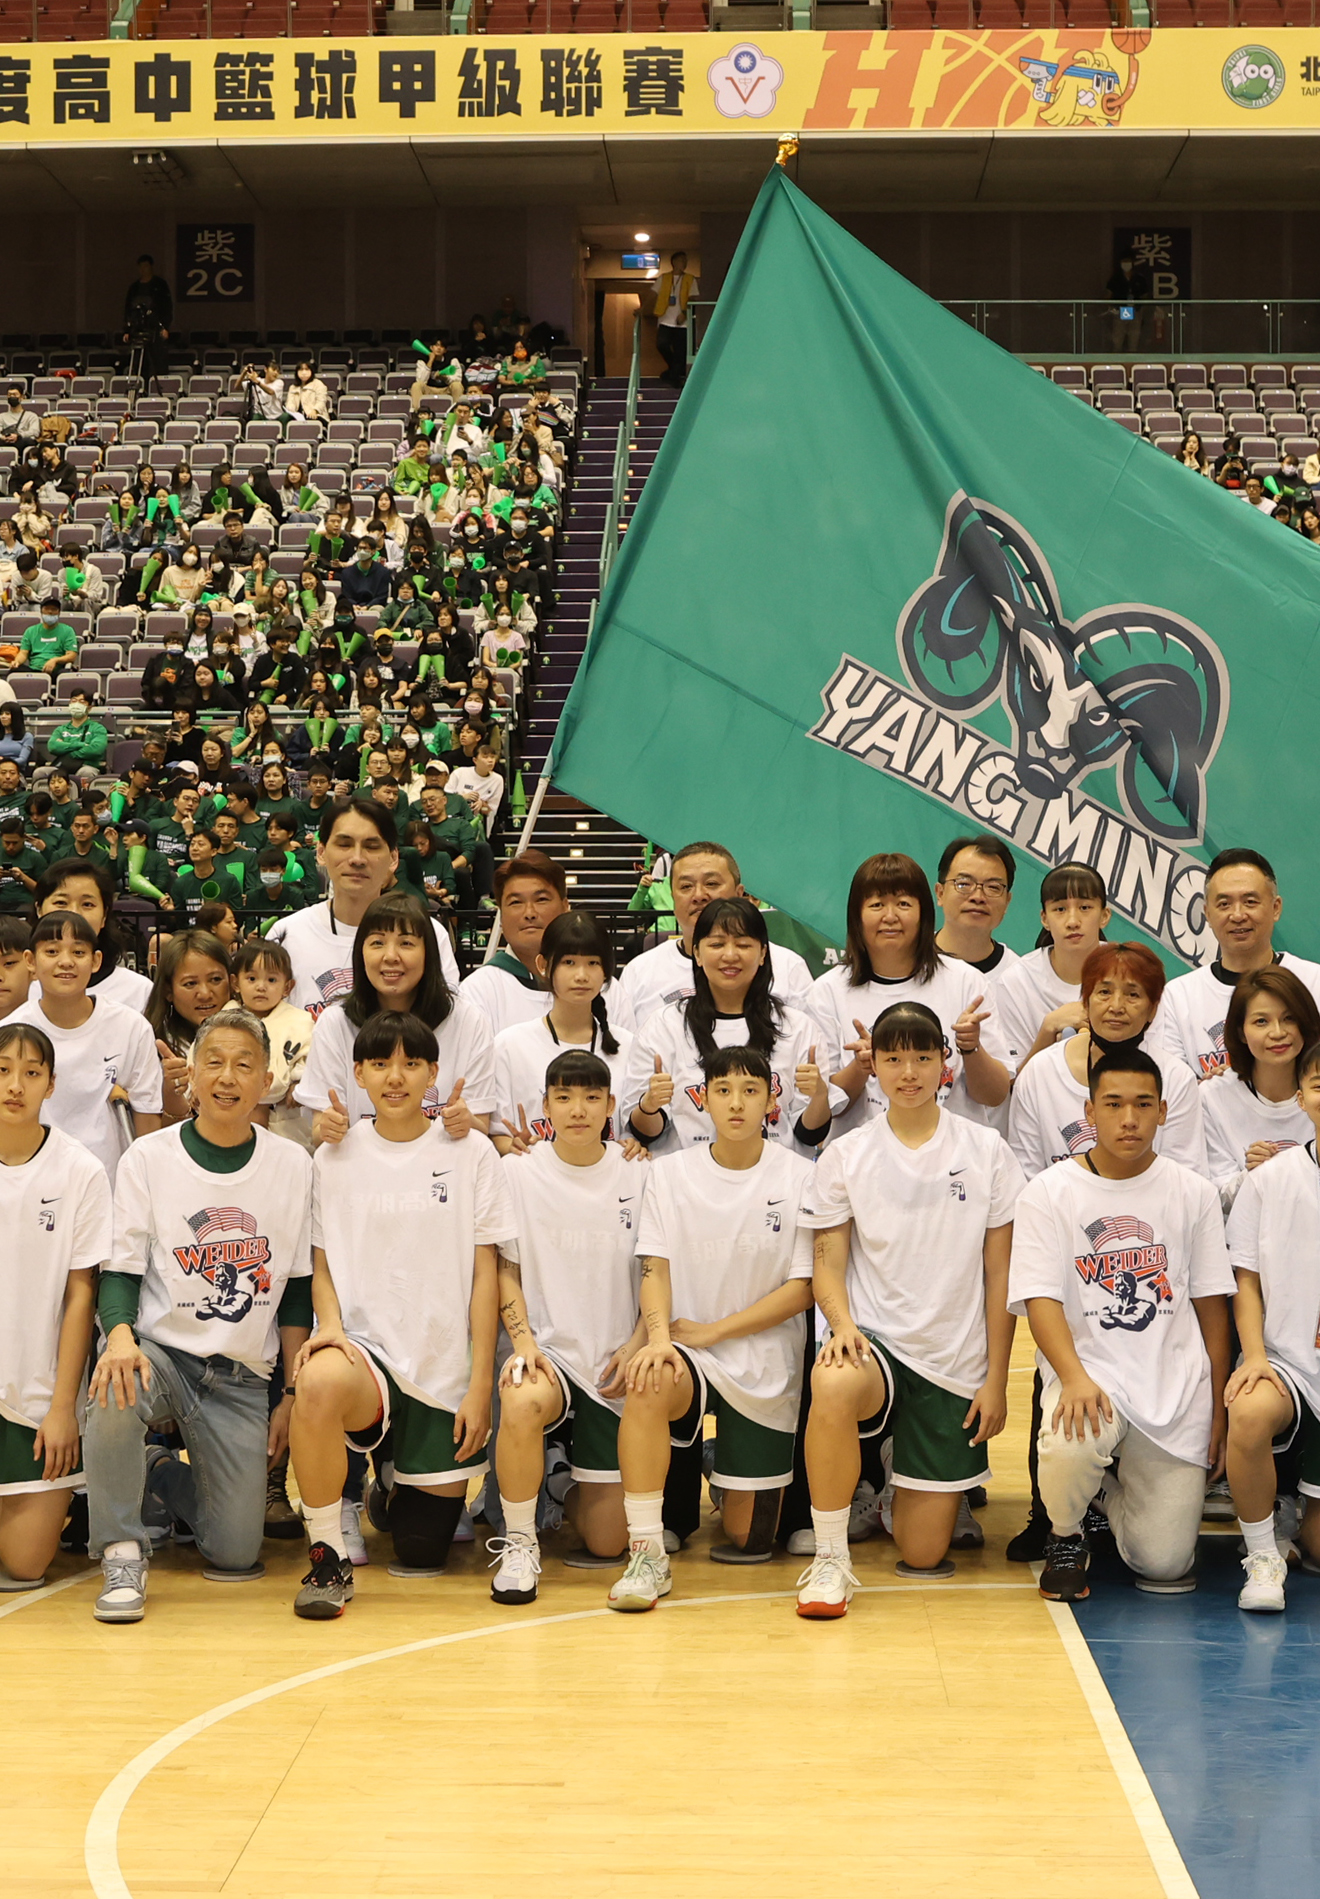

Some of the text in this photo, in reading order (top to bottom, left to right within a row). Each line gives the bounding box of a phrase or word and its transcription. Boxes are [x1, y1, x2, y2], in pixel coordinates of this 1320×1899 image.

[194, 229, 236, 263] 紫
[1131, 233, 1172, 267] 紫
[186, 268, 244, 296] 2C
[813, 659, 1028, 837] YANG
[173, 1236, 271, 1275] WEIDER
[1074, 1244, 1168, 1284] WEIDER
